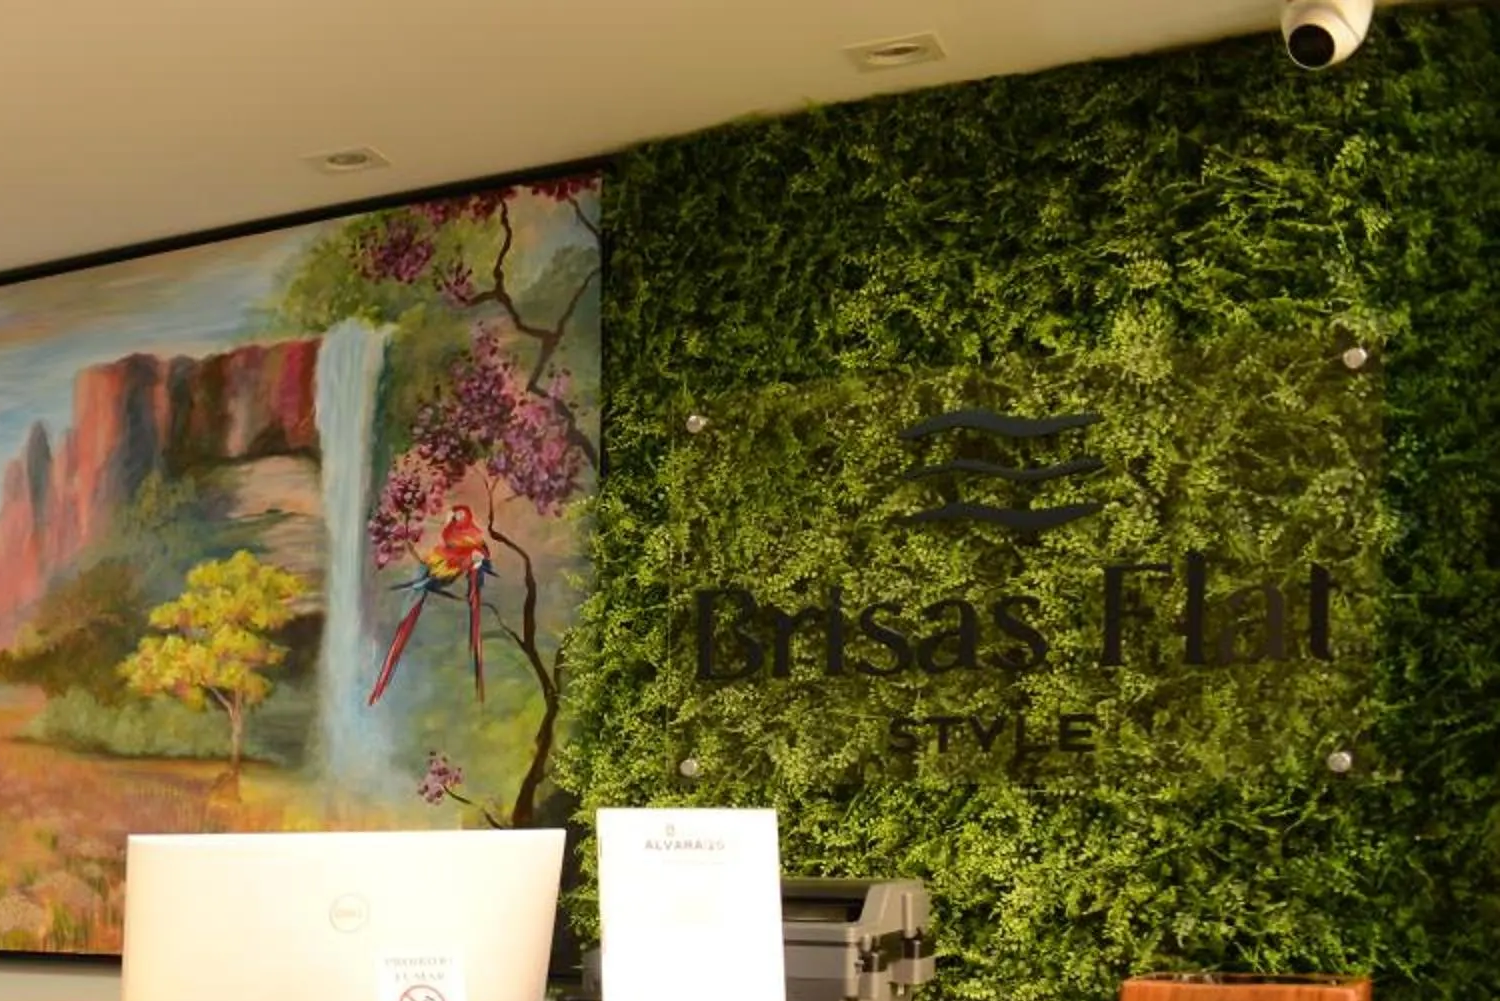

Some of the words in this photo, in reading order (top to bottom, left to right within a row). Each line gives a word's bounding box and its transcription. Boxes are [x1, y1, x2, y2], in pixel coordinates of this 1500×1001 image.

[692, 584, 1052, 684] Brisas
[1100, 550, 1336, 668] Flat
[890, 712, 1100, 755] STYLE
